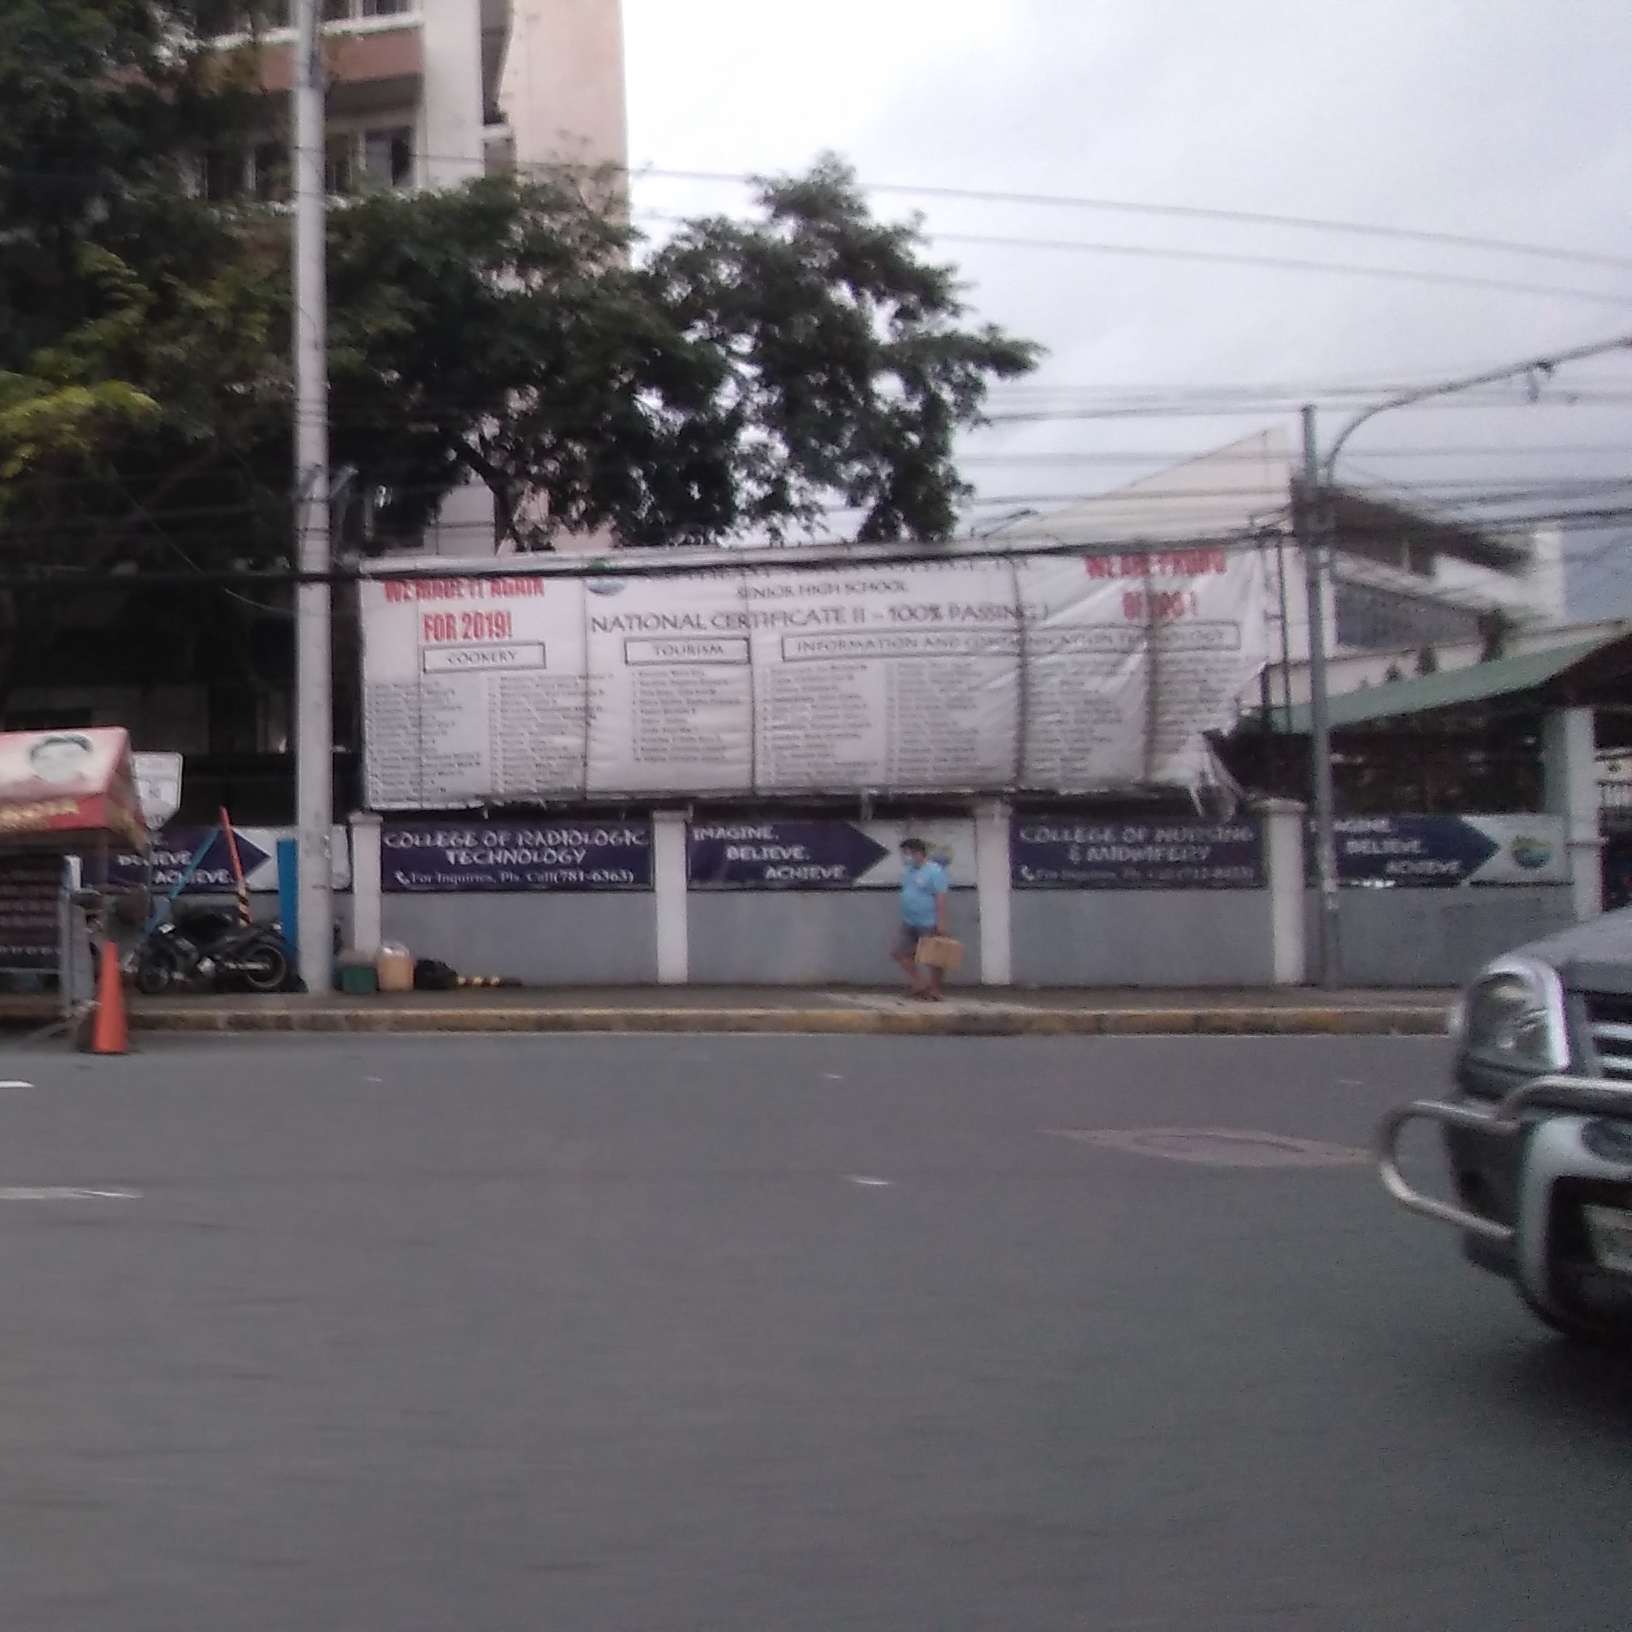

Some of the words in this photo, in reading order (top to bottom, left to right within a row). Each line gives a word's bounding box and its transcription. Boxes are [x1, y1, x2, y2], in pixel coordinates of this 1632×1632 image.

[737, 584, 795, 599] SENIOR
[798, 582, 840, 597] HIGH
[845, 579, 907, 593] SCHOOL
[423, 613, 457, 641] FOR
[462, 609, 513, 640] 2019!
[591, 612, 708, 634] NATIONAL
[711, 605, 847, 631] CERTIFICATE
[888, 604, 944, 624] 100%
[652, 643, 725, 657] TOURISM
[797, 637, 919, 652] INFORMATION
[447, 650, 518, 665] COOKERY
[384, 830, 478, 848] COLLEGE
[483, 829, 511, 847] OF
[518, 828, 648, 848] RADIOLOGIC
[692, 826, 780, 841] IMAGINE.
[1020, 826, 1115, 843] COLLEGE
[1122, 826, 1148, 843] OF
[445, 849, 588, 866] TECHNOLOGY
[725, 844, 810, 861] BELIEVE.
[411, 871, 433, 884] For
